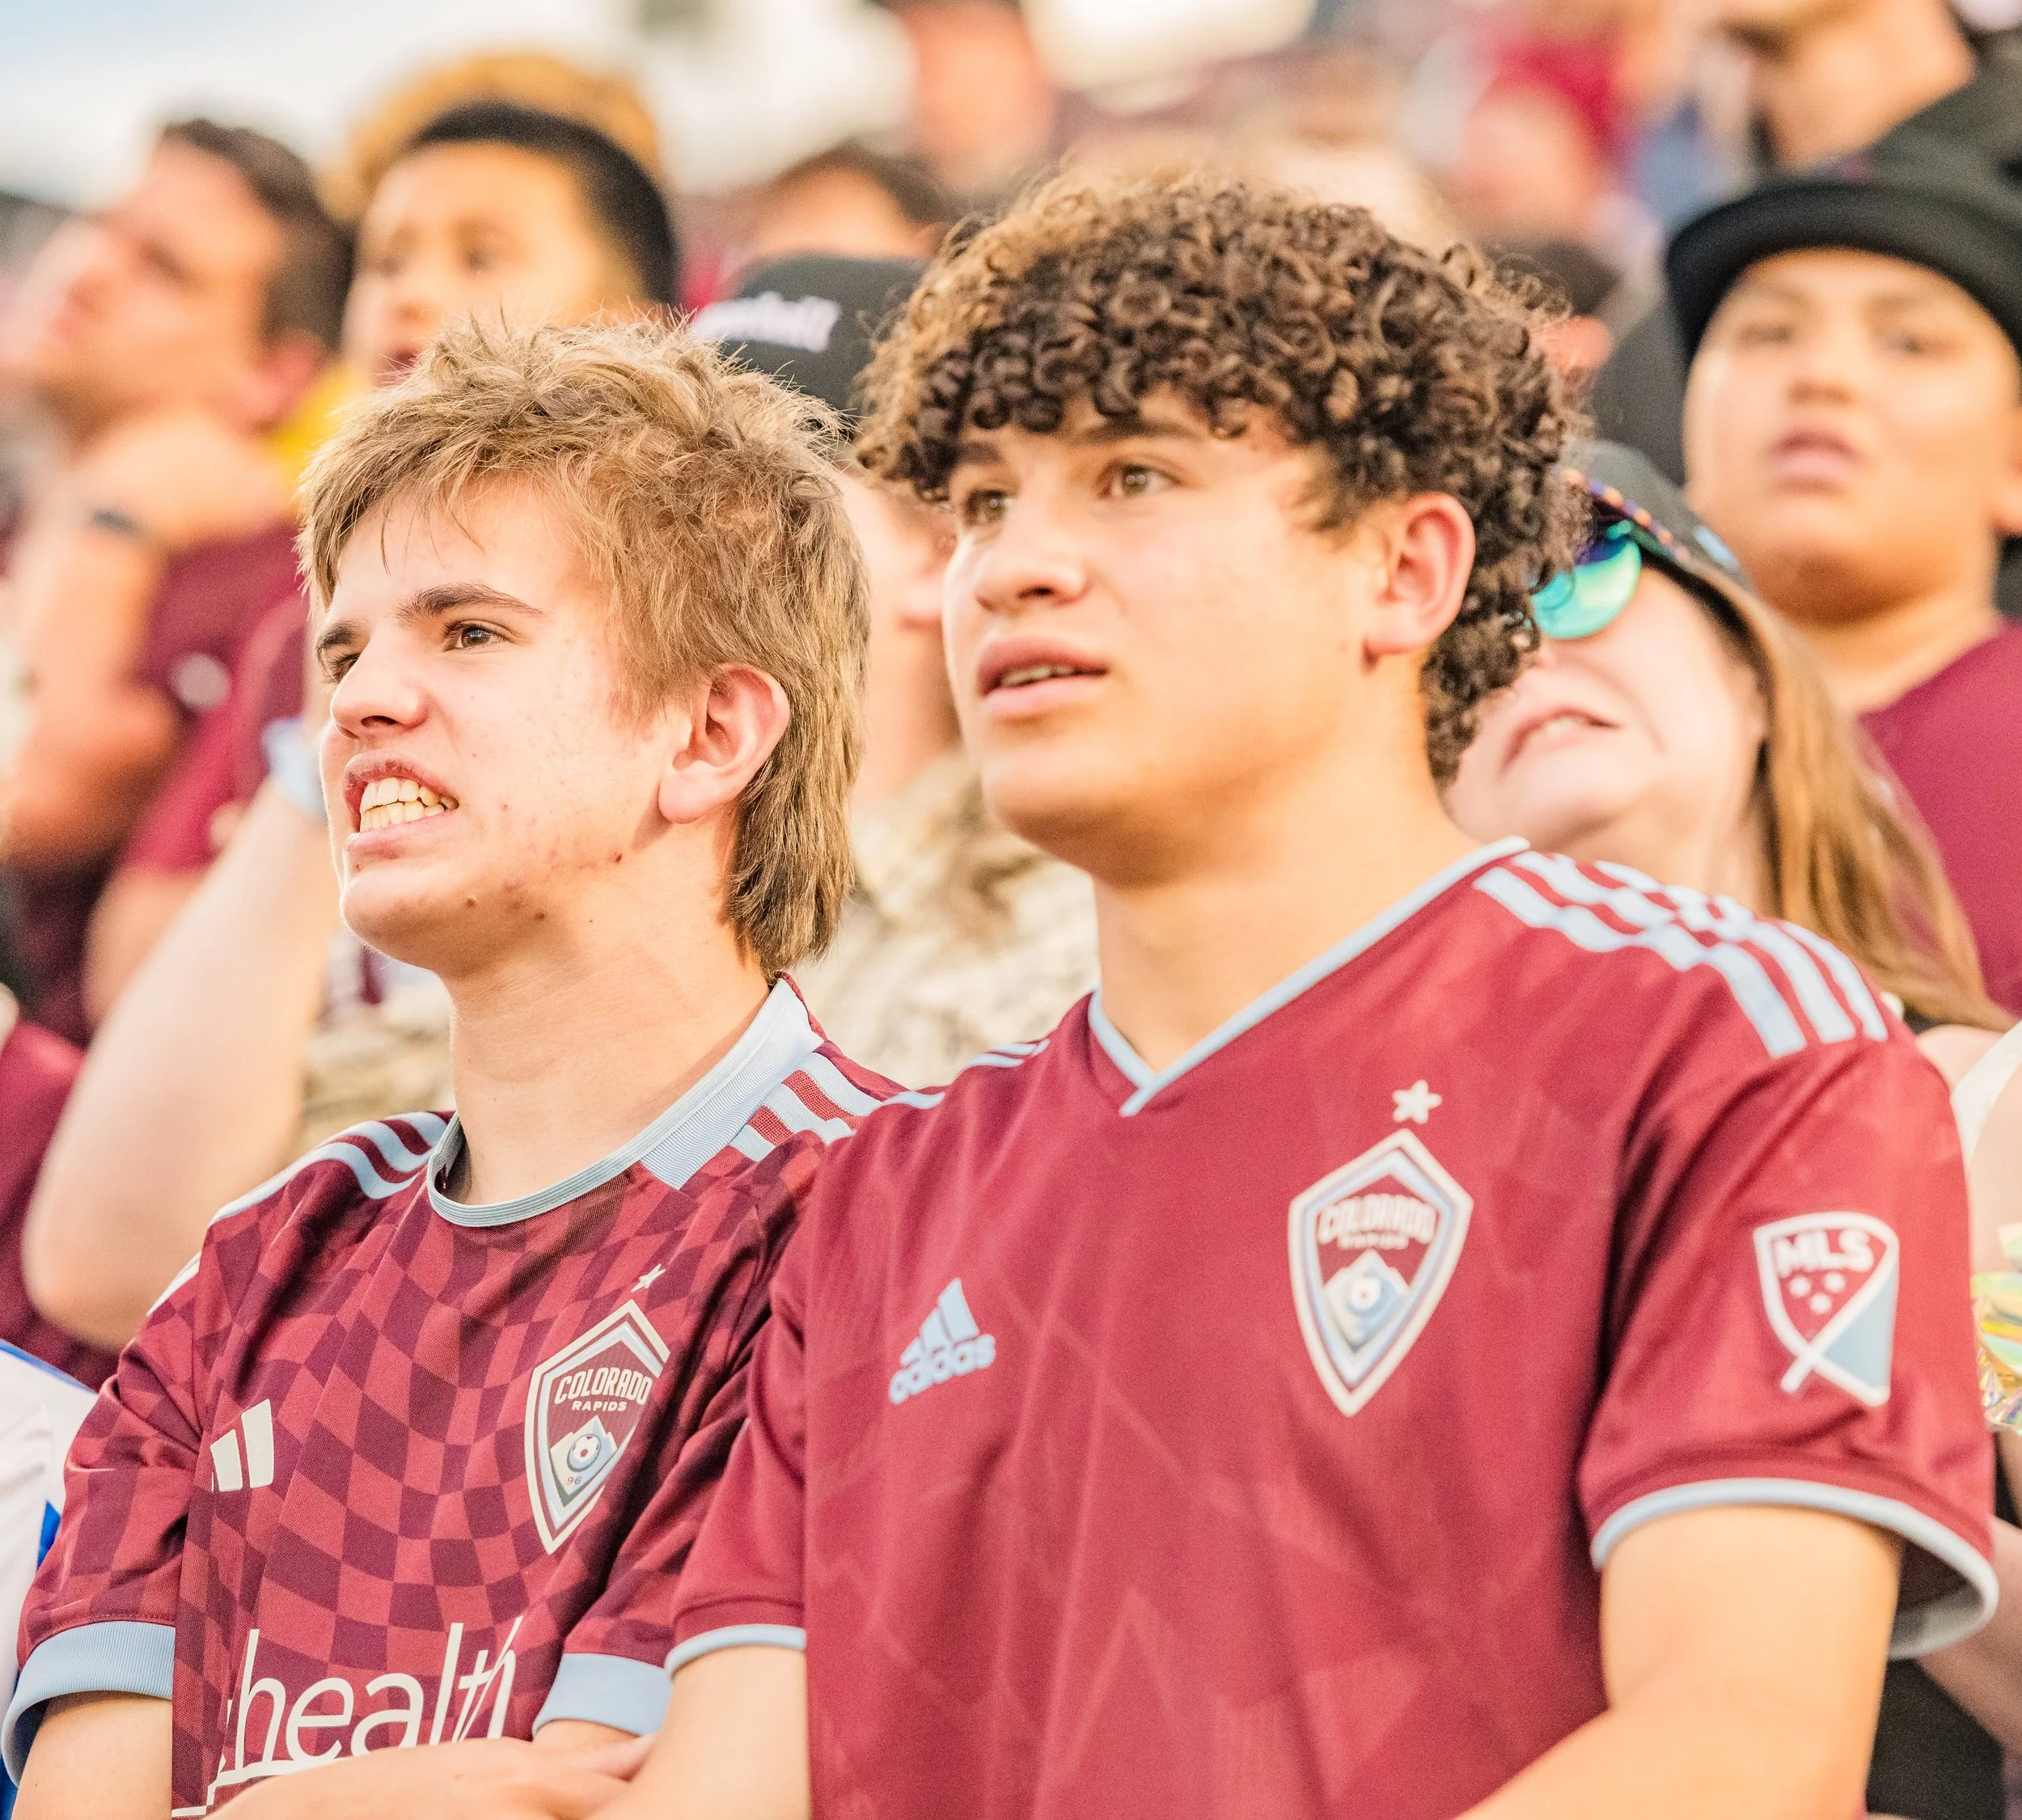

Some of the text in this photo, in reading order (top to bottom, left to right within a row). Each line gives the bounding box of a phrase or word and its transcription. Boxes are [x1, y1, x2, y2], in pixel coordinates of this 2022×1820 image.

[1773, 1227, 1875, 1278] MLS
[554, 1367, 654, 1405] COLORADO
[888, 1333, 996, 1405] adidas
[571, 1400, 628, 1412] RAPIDS
[566, 1475, 583, 1485] 96
[219, 1615, 517, 1771] health
